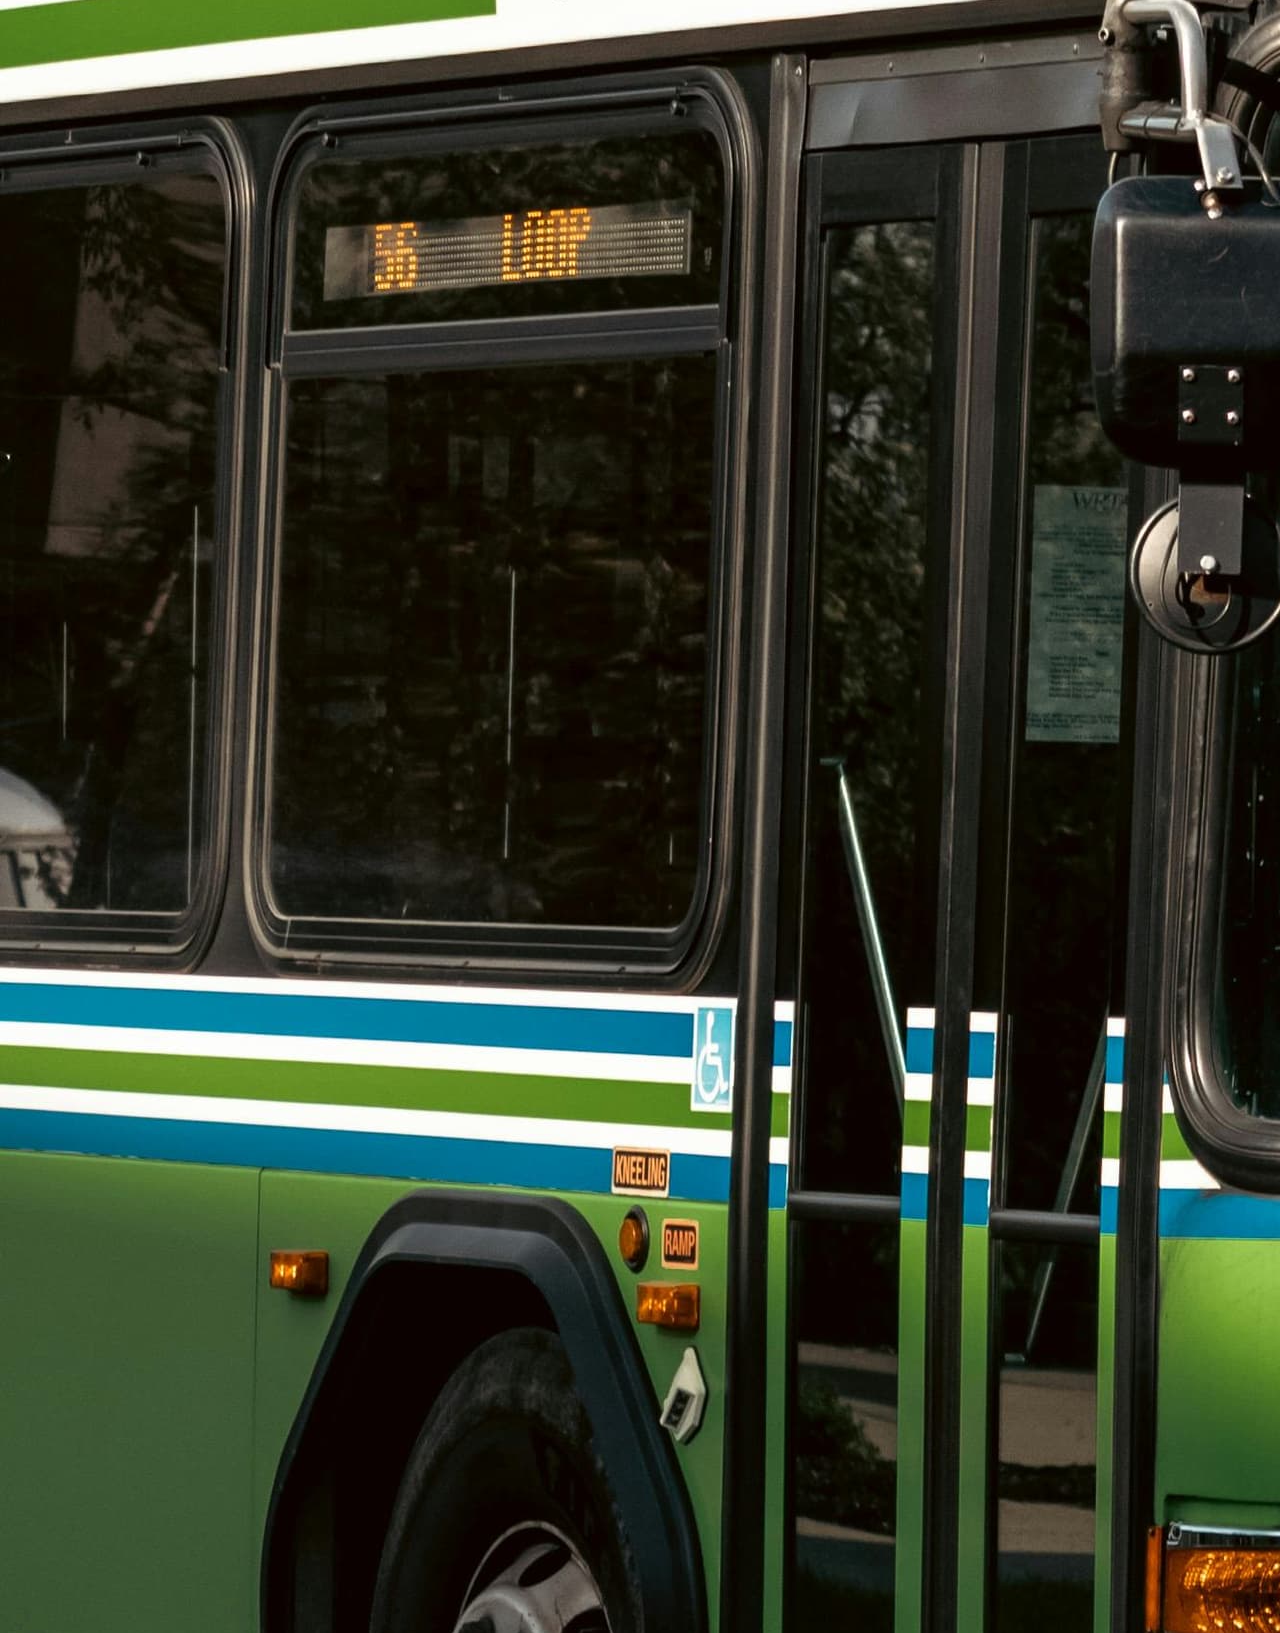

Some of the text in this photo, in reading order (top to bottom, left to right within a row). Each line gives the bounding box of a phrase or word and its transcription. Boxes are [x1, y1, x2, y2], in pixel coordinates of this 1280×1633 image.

[374, 221, 418, 291] 56
[615, 1154, 666, 1187] KNEELING
[664, 1229, 696, 1257] RAMP
